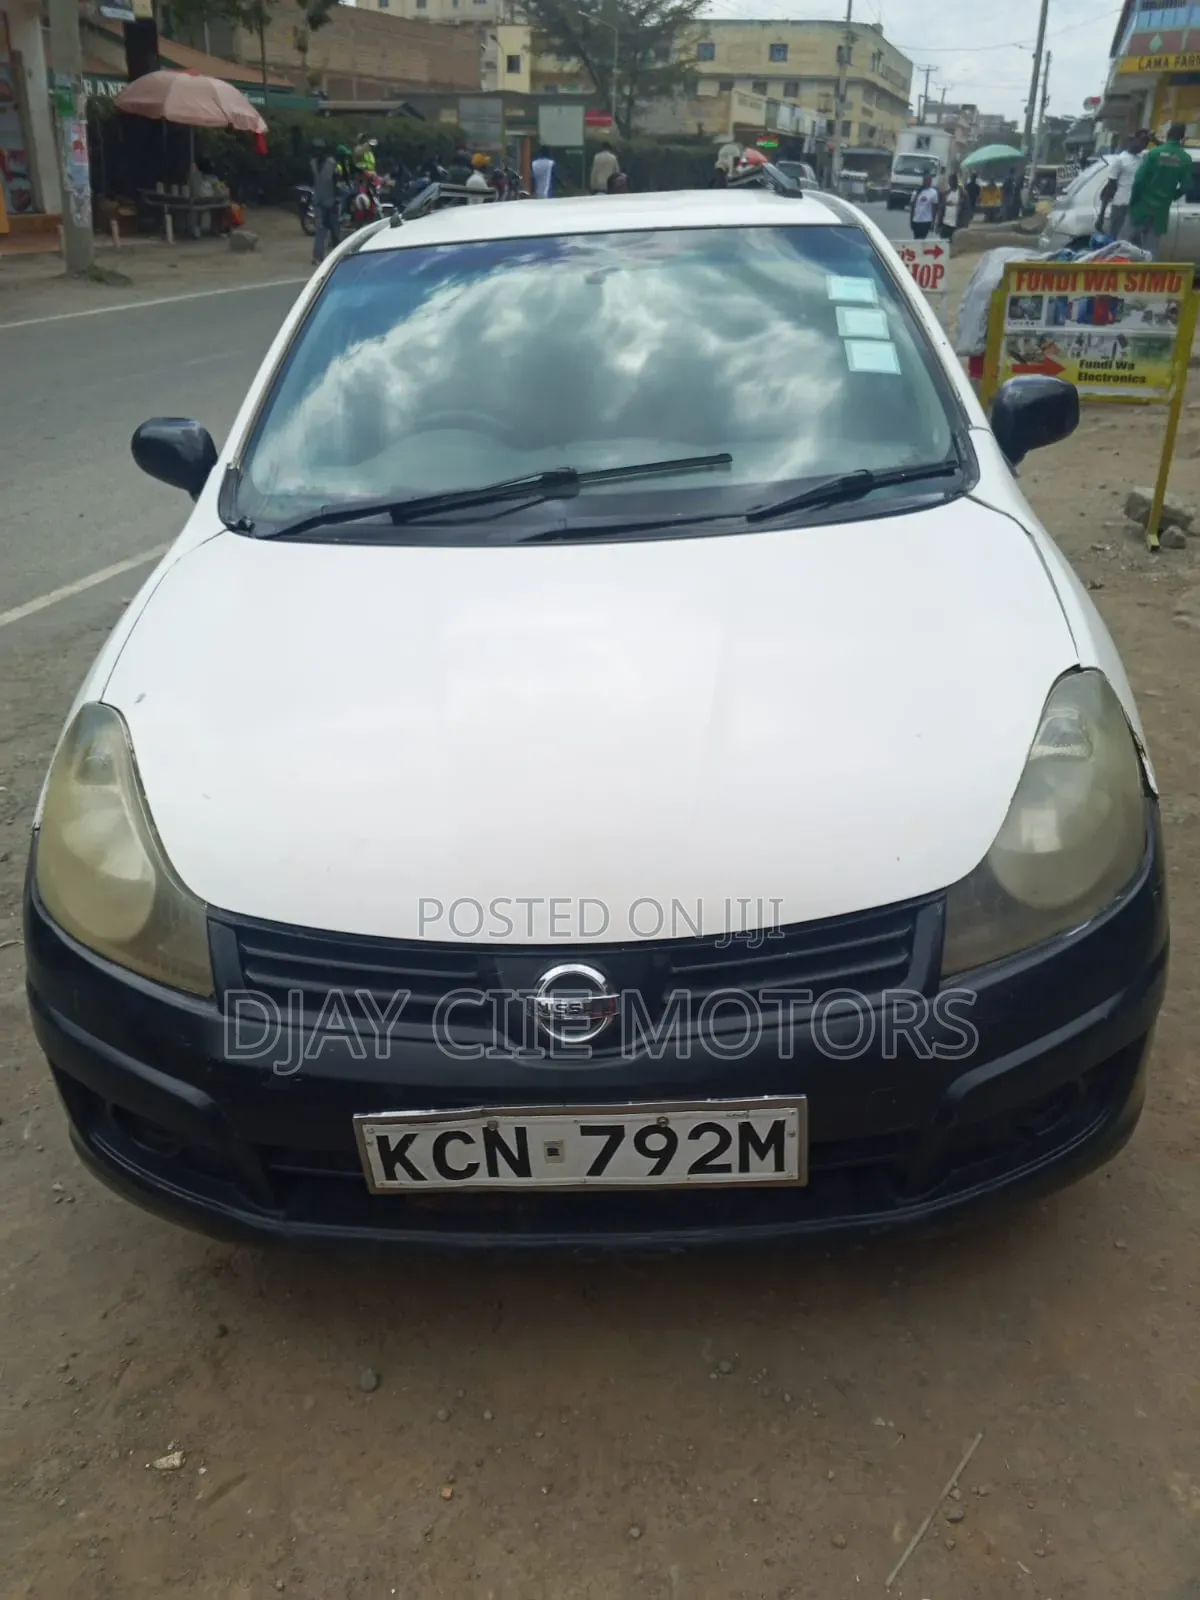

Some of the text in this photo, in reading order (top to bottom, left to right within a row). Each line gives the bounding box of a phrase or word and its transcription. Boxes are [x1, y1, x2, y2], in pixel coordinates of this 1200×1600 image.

[1016, 270, 1078, 292] FUNDI
[1083, 270, 1118, 292] WA
[1078, 359, 1136, 371] Fundi Wa
[1078, 371, 1147, 384] Electronics
[375, 1119, 787, 1182] KCN 792M
